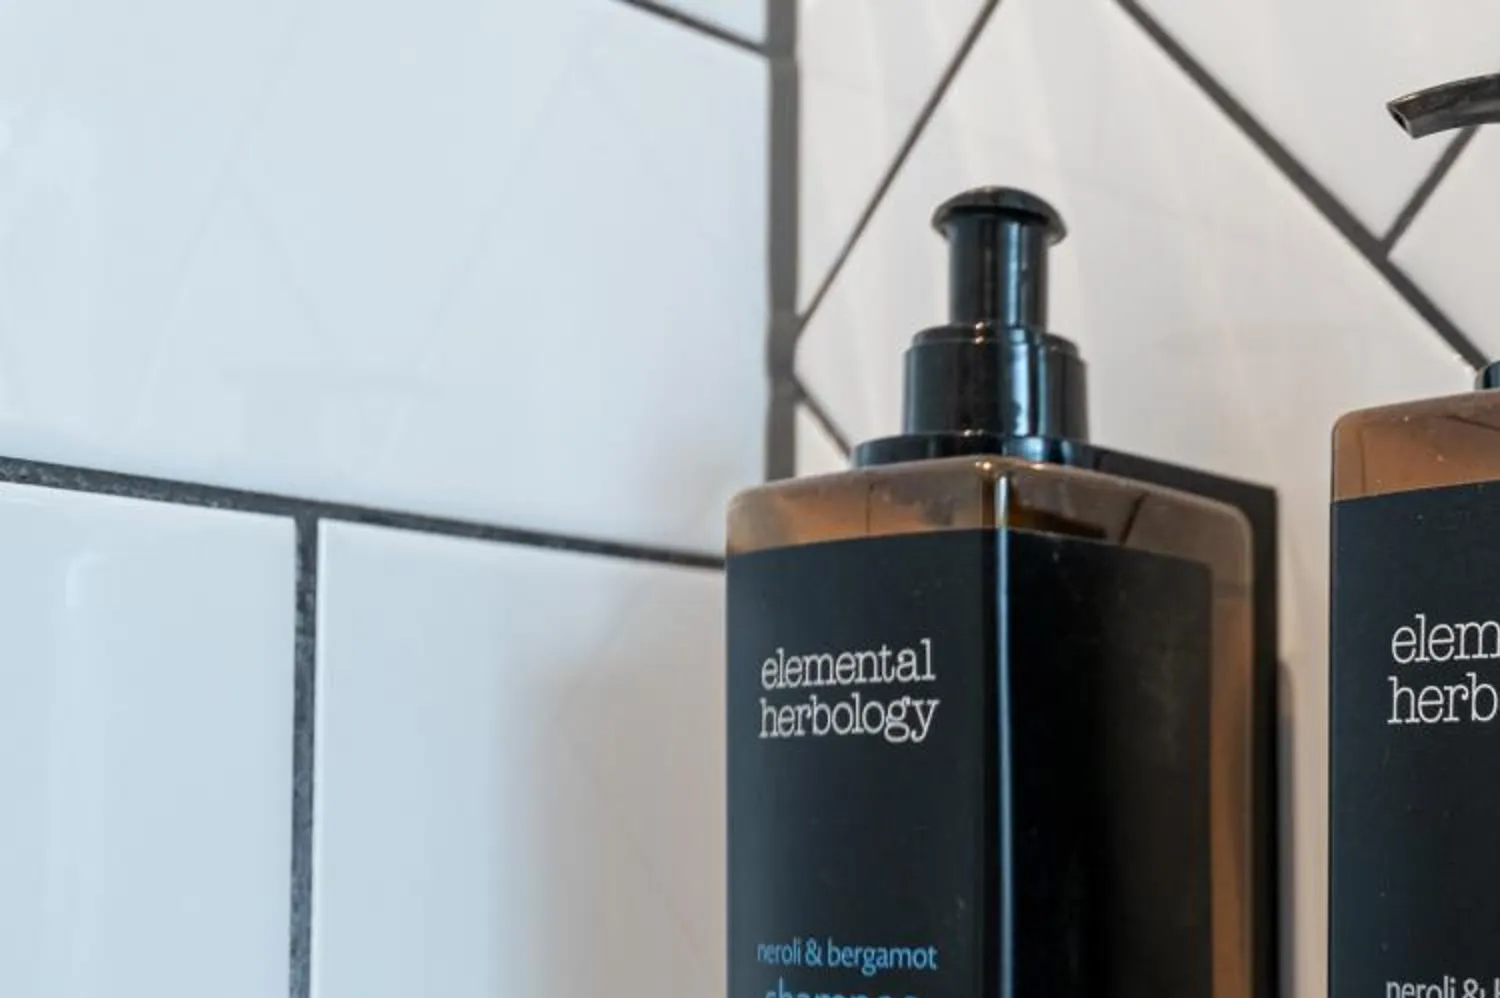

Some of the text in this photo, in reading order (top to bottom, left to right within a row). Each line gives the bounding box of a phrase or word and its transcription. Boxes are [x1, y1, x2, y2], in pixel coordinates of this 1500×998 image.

[761, 638, 937, 691] elemental
[758, 691, 941, 743] herbology
[757, 937, 938, 977] neroli & bergamot
